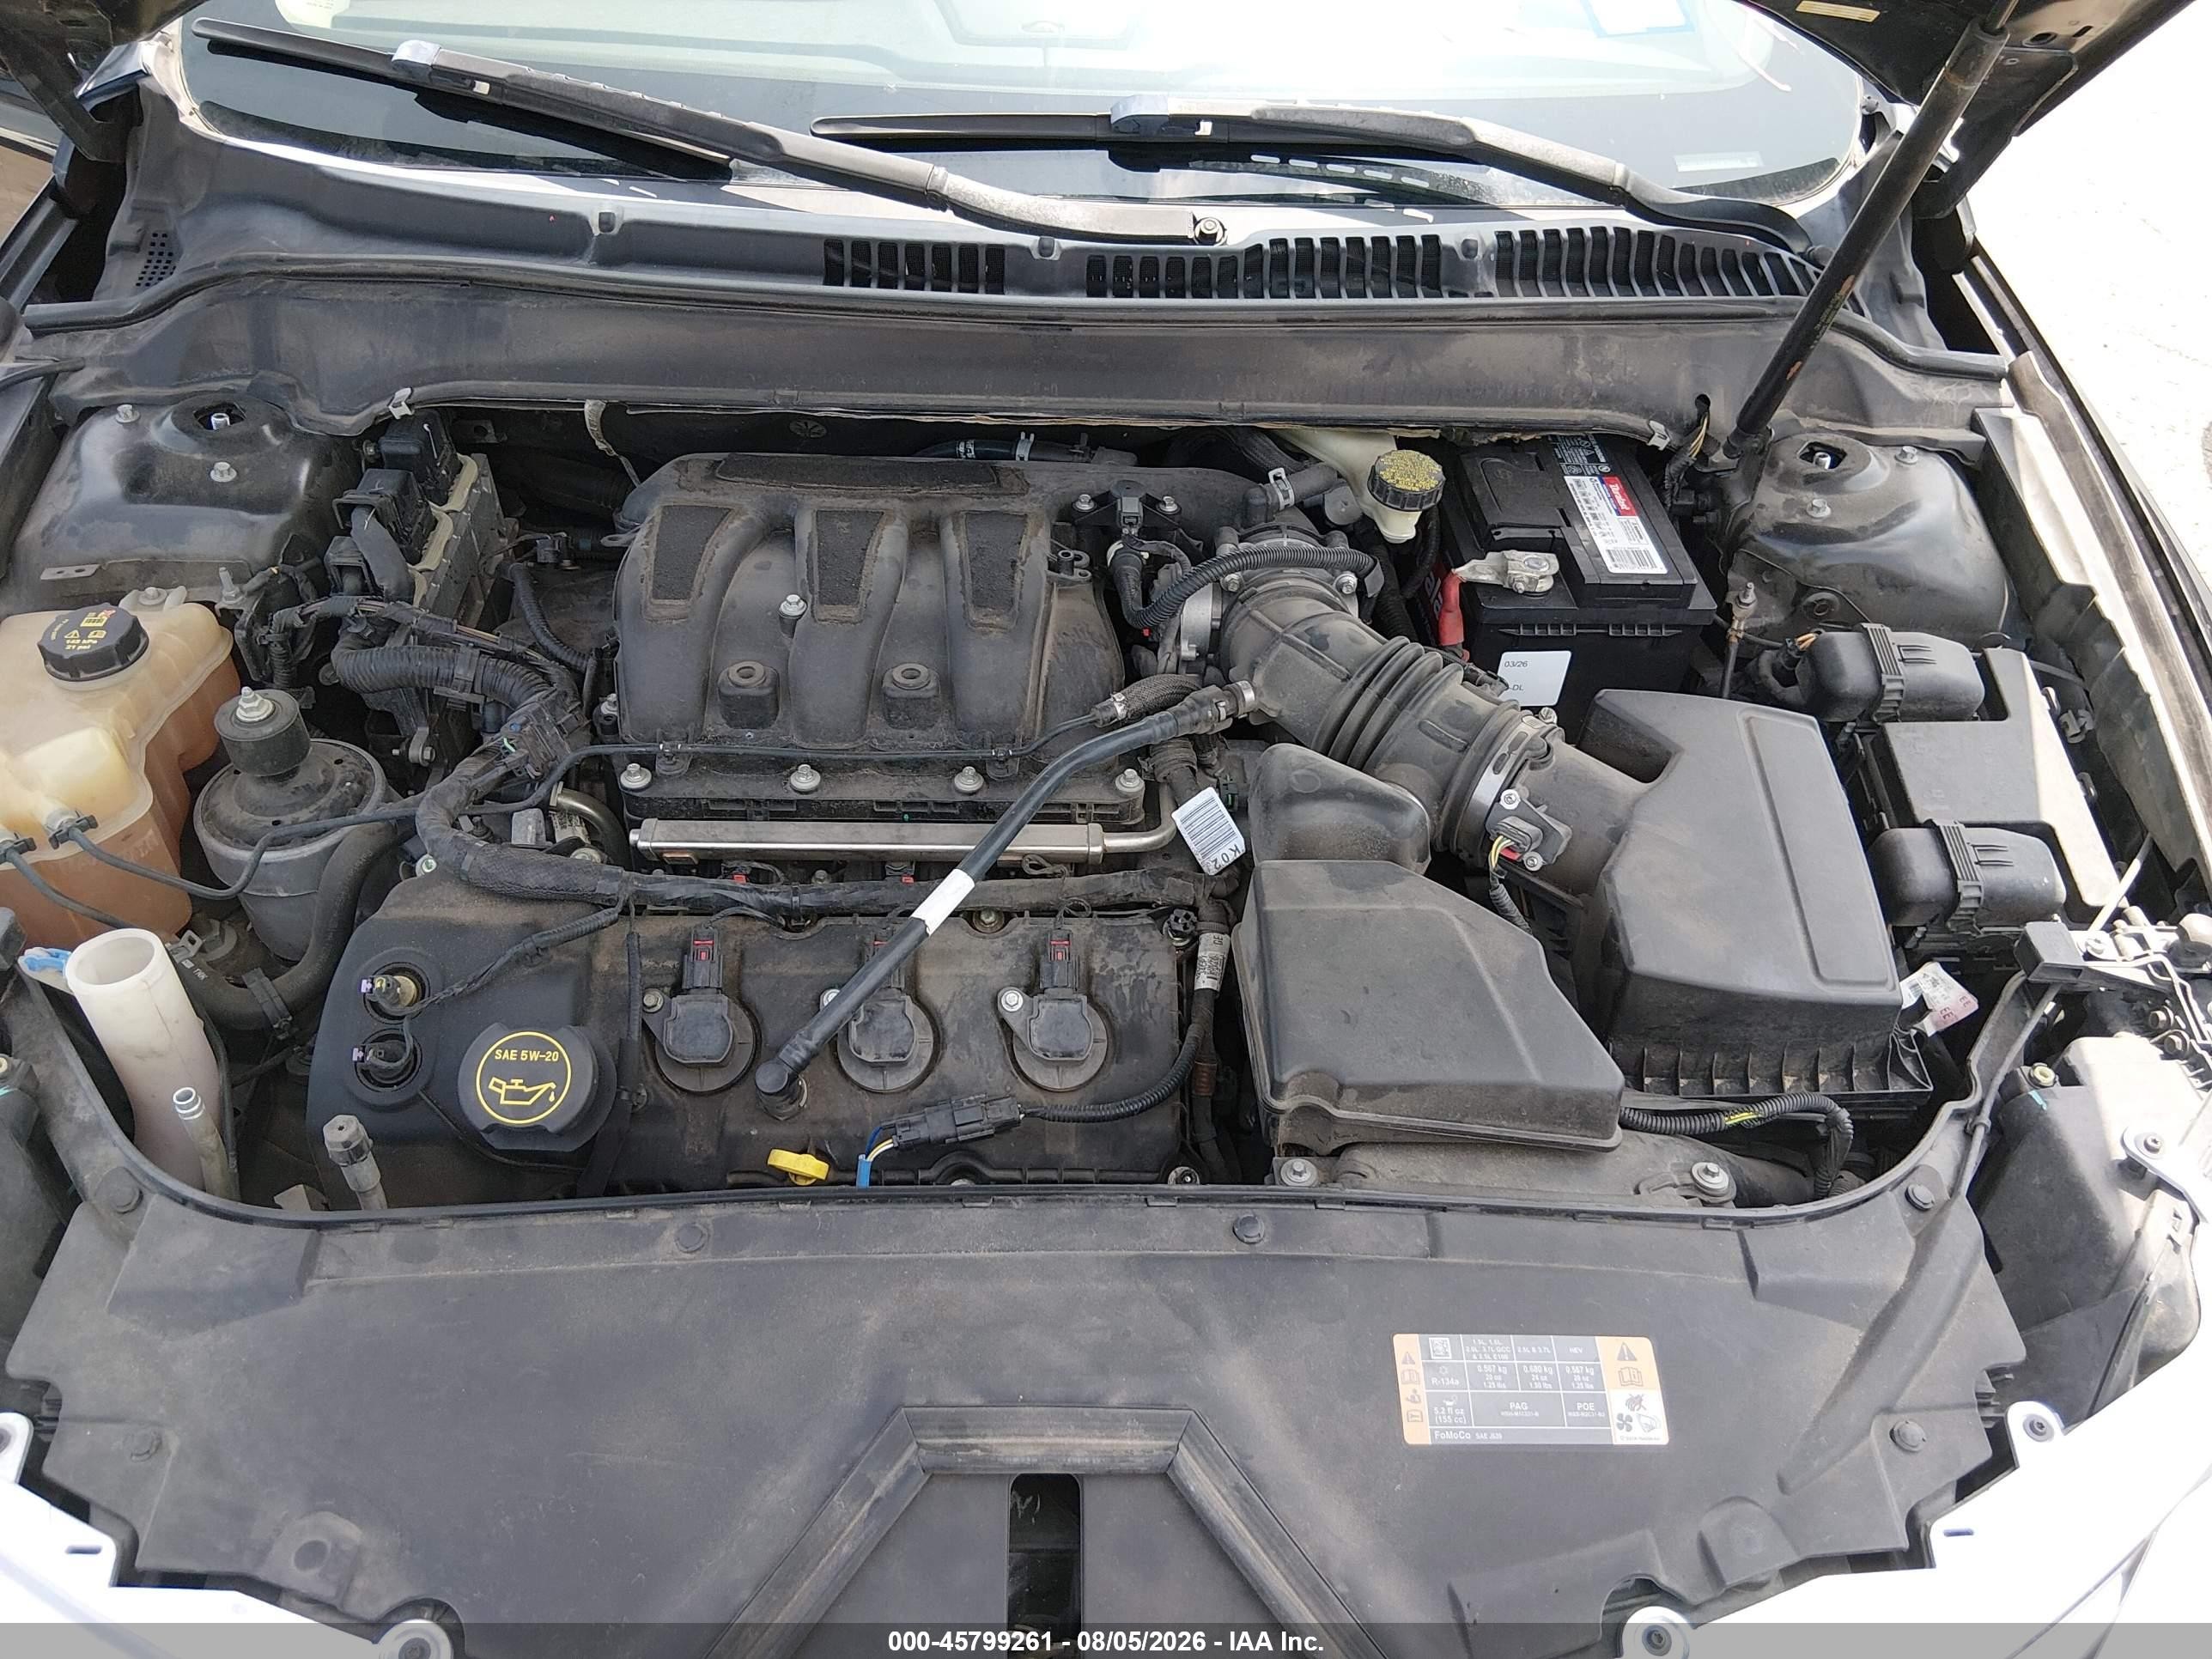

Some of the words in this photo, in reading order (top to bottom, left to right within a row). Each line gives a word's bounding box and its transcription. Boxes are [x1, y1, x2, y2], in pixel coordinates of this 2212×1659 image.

[495, 1049, 517, 1060] SAE
[520, 1049, 560, 1061] 5W-20
[1498, 1365, 1508, 1374] kg
[1544, 1365, 1553, 1375] kg
[1586, 1365, 1595, 1376] kg
[1431, 1377, 1460, 1386] R-134a
[1510, 1401, 1528, 1410] PAG
[1577, 1402, 1595, 1411] POE
[1434, 1407, 1446, 1415] 5.2
[1435, 1415, 1453, 1425] (155
[1453, 1415, 1467, 1425] cc)
[1434, 1431, 1471, 1439] FoMoCo
